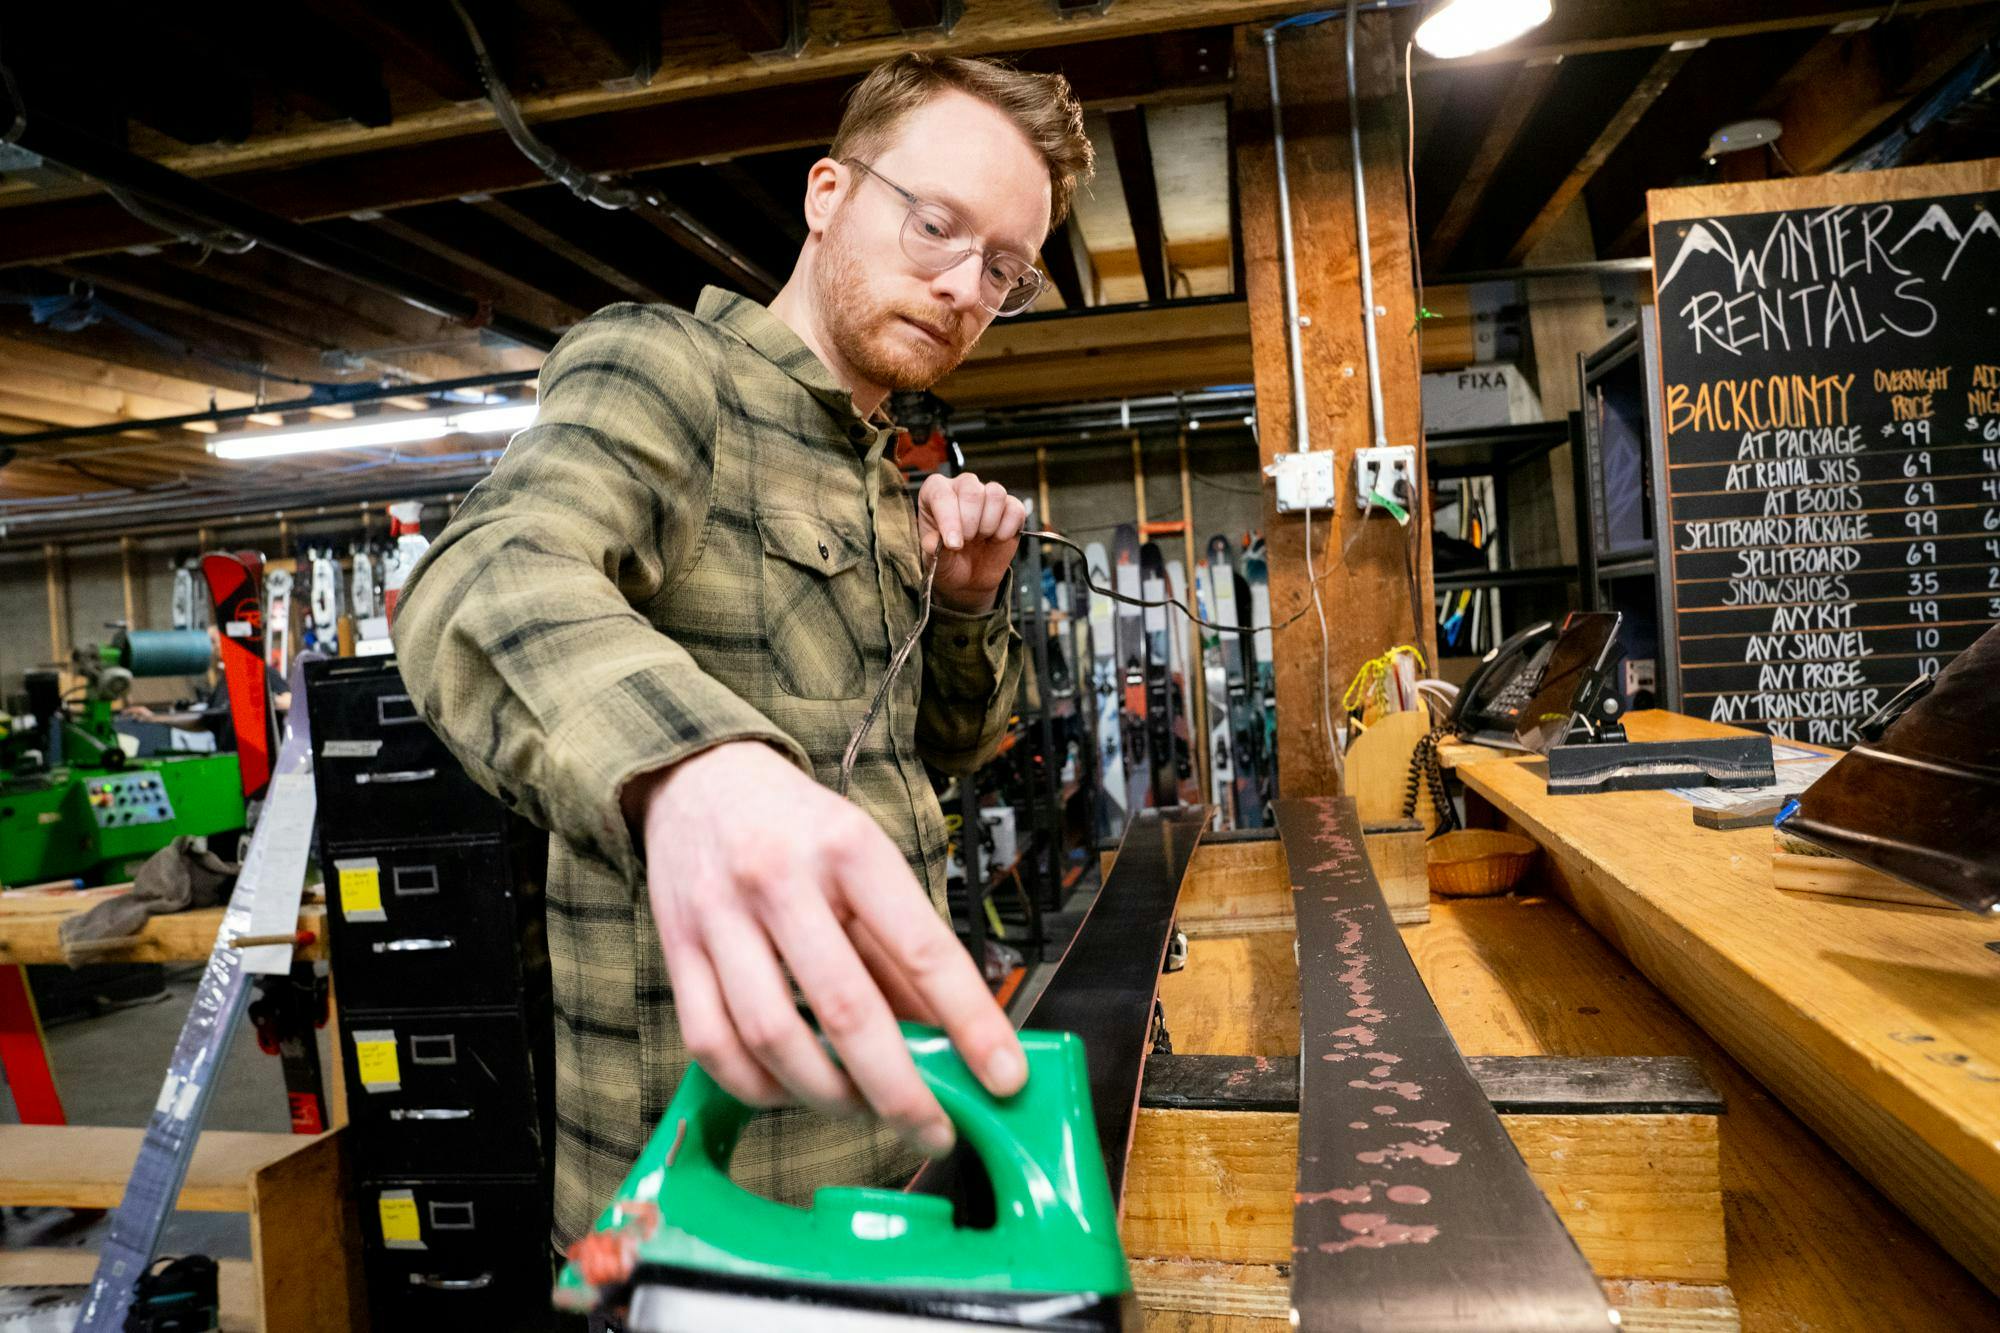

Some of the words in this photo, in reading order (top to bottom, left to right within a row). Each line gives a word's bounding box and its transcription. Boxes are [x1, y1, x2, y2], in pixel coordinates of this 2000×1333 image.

[1707, 204, 1912, 293] WINTER
[1679, 277, 1938, 356] RENTALS
[1457, 371, 1508, 390] FIXA
[1873, 366, 1952, 394] OVERNIGHT
[1667, 373, 1856, 435] BACKCOUNTY
[1891, 393, 1936, 421] PRICE
[1967, 389, 2000, 416] NIG
[1737, 431, 1771, 461] AT
[1775, 425, 1867, 459] PACKAGE
[1725, 463, 1752, 491] AT
[1755, 458, 1814, 489] RENTAL
[1815, 457, 1861, 484] SKIS
[1903, 451, 1932, 478] 69
[1982, 448, 2000, 471] 4
[1764, 488, 1793, 518] AT
[1796, 485, 1863, 514] BOOTS
[1904, 482, 1935, 506] 69
[1982, 478, 2000, 501] 4
[1681, 518, 1792, 551] SPLITBOARD
[1795, 512, 1873, 543] PACKAGE
[1905, 510, 1938, 536] 99
[1983, 507, 2000, 530] 6
[1731, 546, 1861, 578] SPLITBOARD
[1905, 541, 1937, 566] 69
[1985, 538, 2000, 559] 4
[1722, 575, 1850, 605] SNOWSHOES
[1907, 571, 1940, 596] 35
[1988, 567, 2000, 589] 2
[1771, 605, 1814, 633] AVY
[1817, 602, 1857, 629] KIT
[1909, 600, 1940, 622] 49
[1745, 635, 1786, 663] AVY
[1788, 630, 1874, 660] SHOVEL
[1916, 628, 1940, 650] 10
[1758, 663, 1796, 692] AVY
[1802, 659, 1867, 690] PROBE
[1918, 657, 1940, 681] 10
[1710, 693, 1749, 723] AVY
[1750, 688, 1880, 719] TRANSCEIVER
[1767, 719, 1795, 741] SKI
[1807, 718, 1861, 744] PACK
